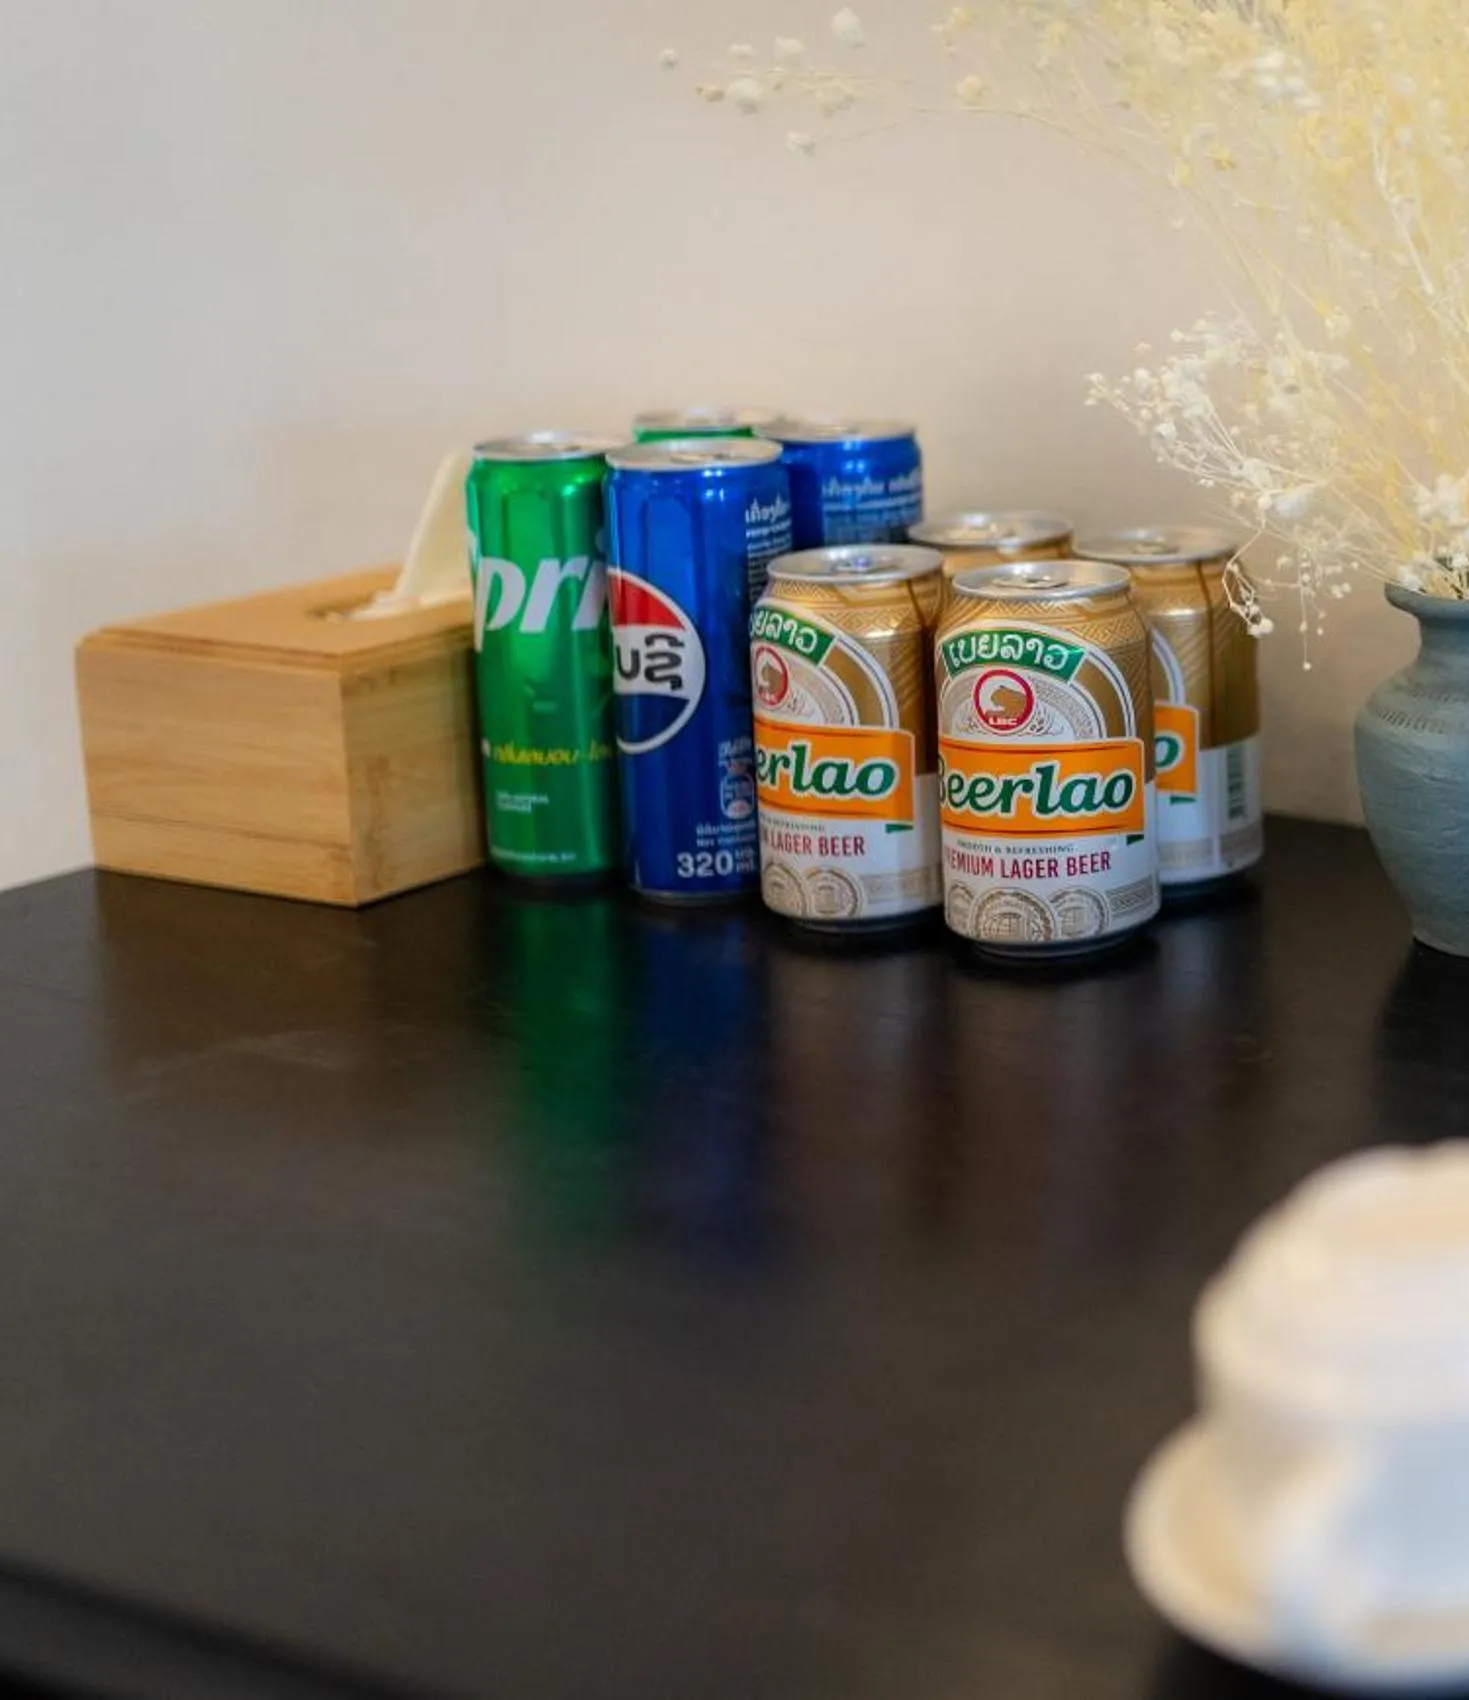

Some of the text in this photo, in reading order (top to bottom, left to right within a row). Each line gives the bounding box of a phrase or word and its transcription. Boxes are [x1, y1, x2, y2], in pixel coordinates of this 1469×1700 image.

[468, 529, 607, 652] pri
[949, 633, 1069, 670] ເບຍລາວ
[756, 743, 896, 796] erlao
[771, 831, 812, 856] LAGER
[818, 835, 866, 857] BEER
[677, 850, 734, 878] 320
[1001, 858, 1059, 879] LAGER
[1066, 851, 1112, 877] BEER
